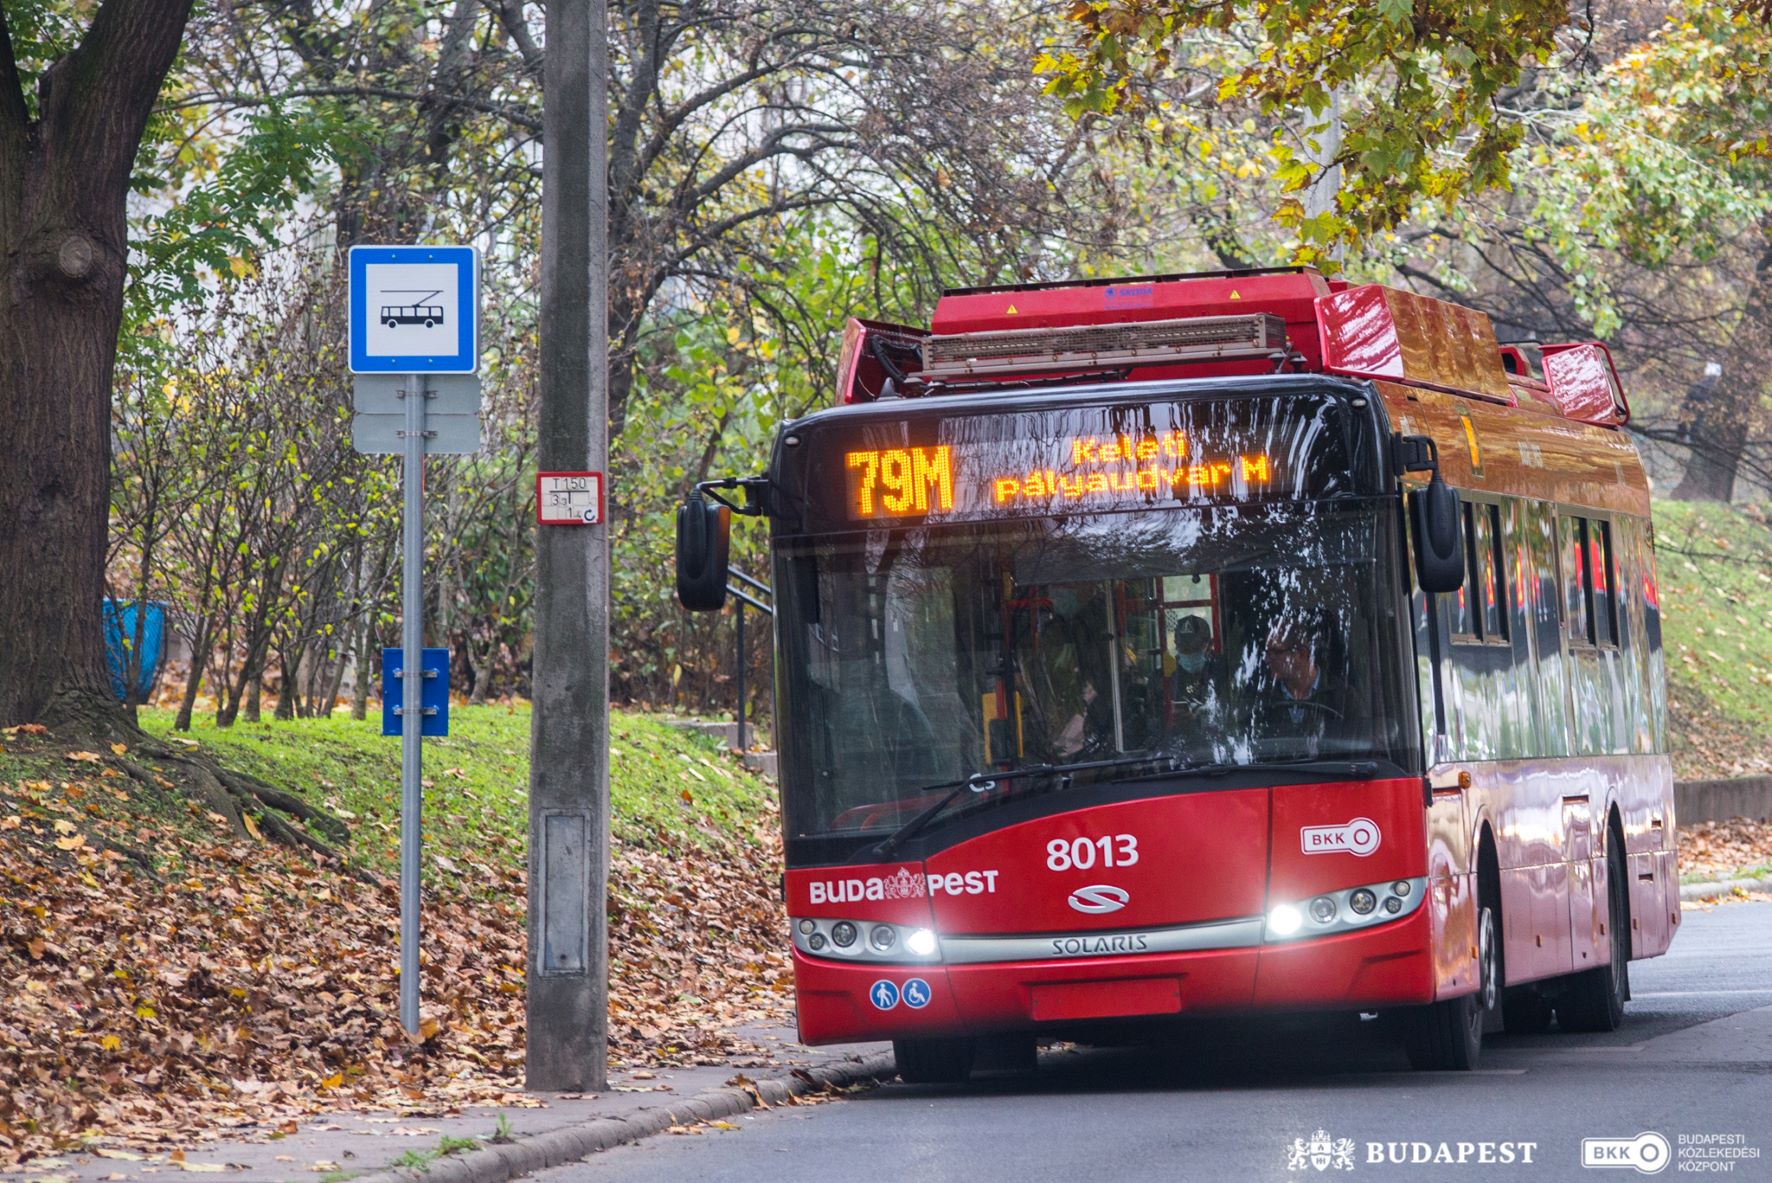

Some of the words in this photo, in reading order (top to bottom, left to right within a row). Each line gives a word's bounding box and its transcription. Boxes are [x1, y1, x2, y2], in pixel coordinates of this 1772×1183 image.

[1072, 432, 1187, 465] Keleti
[563, 477, 587, 490] 150
[847, 445, 953, 514] 79M
[994, 461, 1232, 503] pályaudvar
[1240, 455, 1269, 482] M
[1046, 833, 1139, 872] 8013
[1312, 832, 1345, 846] BKK
[1052, 935, 1148, 955] SOLARIS
